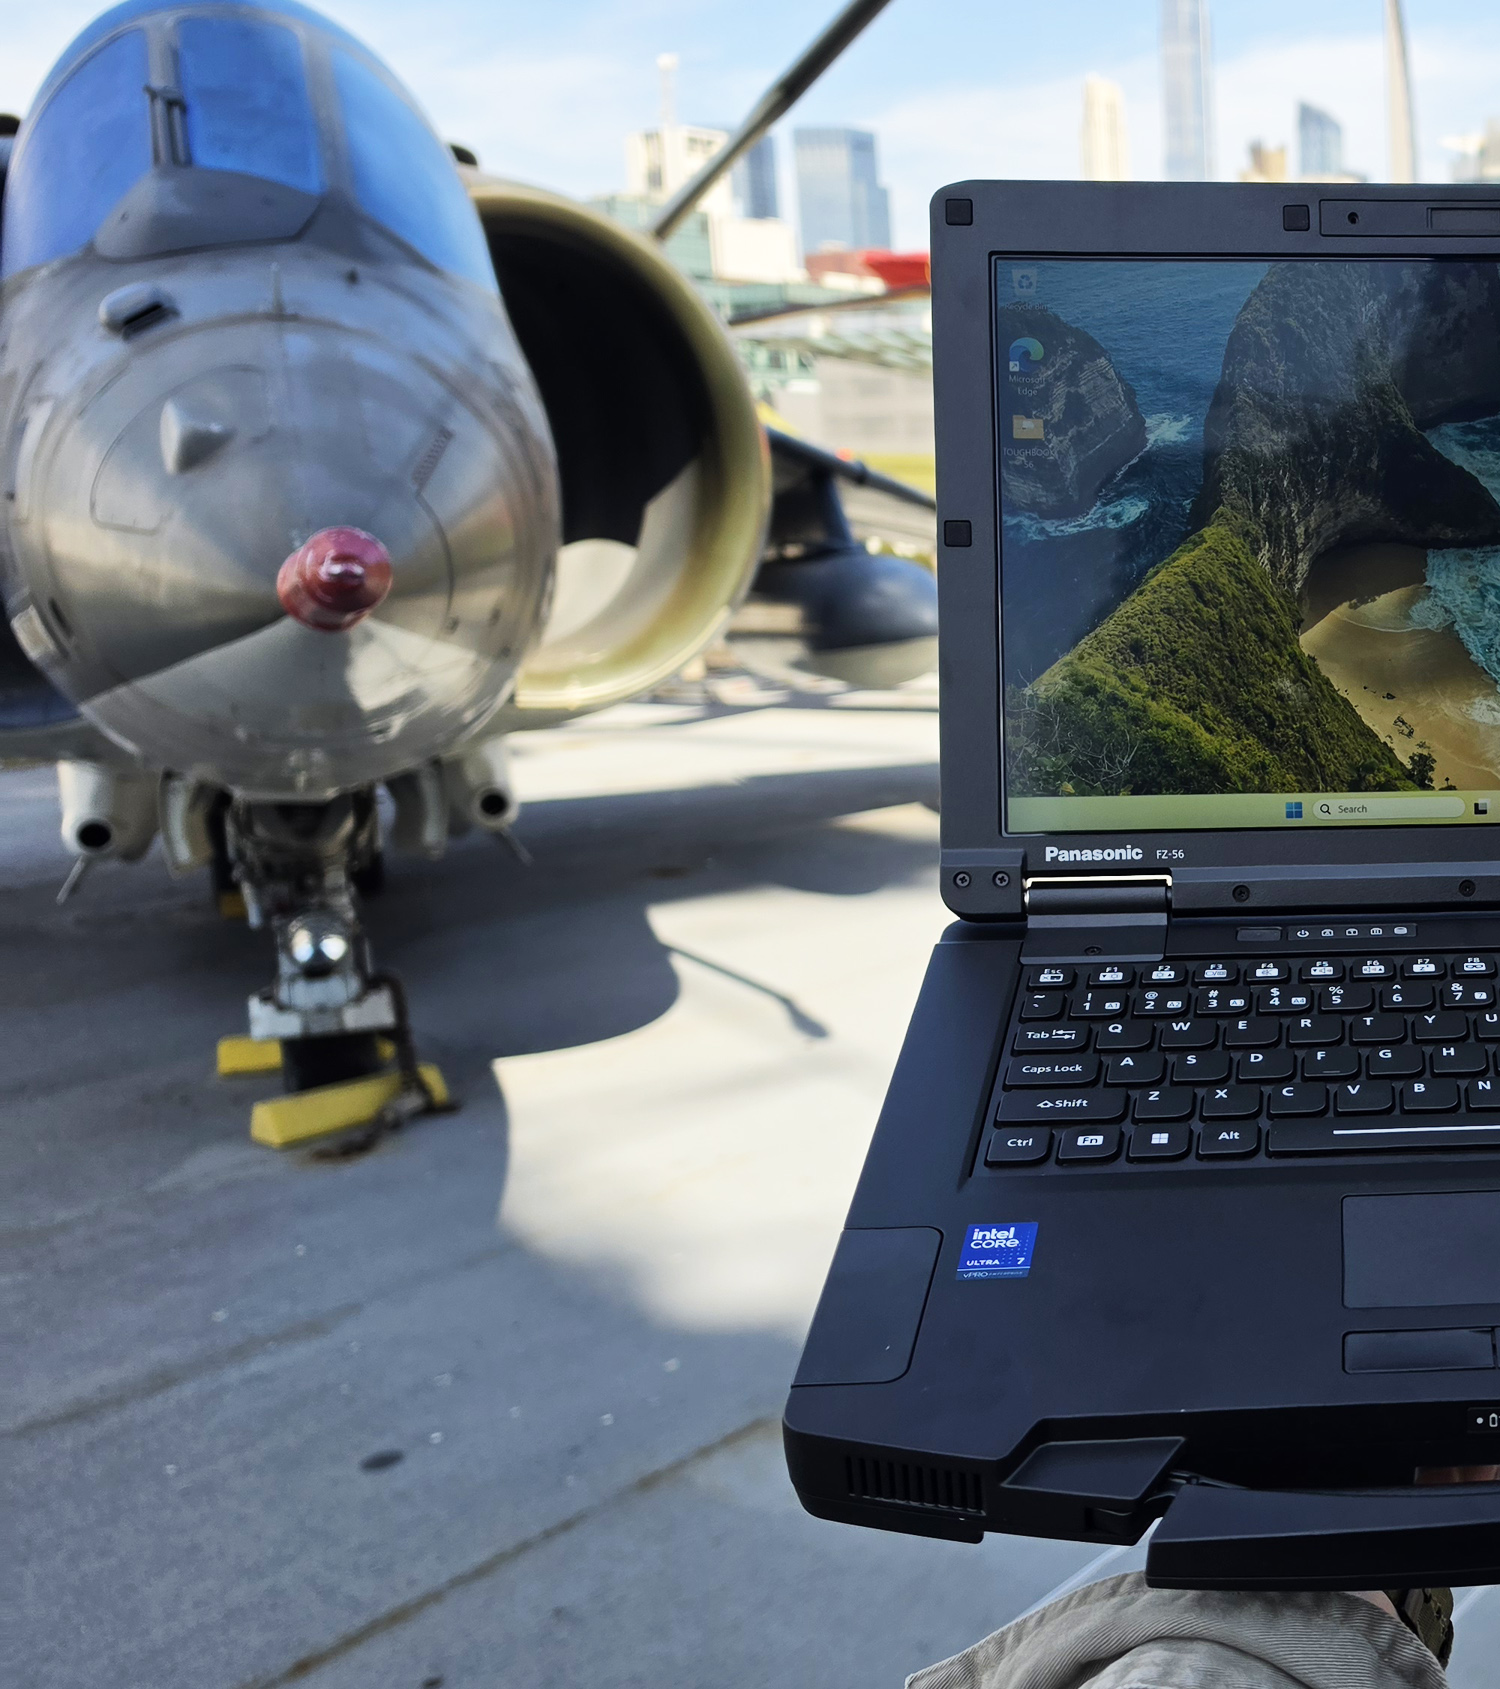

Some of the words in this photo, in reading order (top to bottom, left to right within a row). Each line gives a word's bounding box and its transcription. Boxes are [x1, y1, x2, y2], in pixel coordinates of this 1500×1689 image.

[1338, 805, 1367, 814] Search
[1045, 845, 1143, 862] Panasonic
[1156, 850, 1185, 859] FZ-56
[1328, 986, 1344, 995] %
[1451, 983, 1463, 991] &
[1145, 991, 1159, 1000] @
[1208, 989, 1219, 998] #
[1270, 987, 1280, 997] $
[1453, 992, 1463, 1000] 7
[1269, 997, 1280, 1006] 4
[1332, 995, 1342, 1004] 5
[1392, 993, 1403, 1002] 6
[1083, 1002, 1091, 1011] 1
[1145, 1001, 1155, 1010] 2
[1208, 999, 1218, 1008] 3
[1362, 1017, 1374, 1026] T
[1424, 1015, 1436, 1024] Y
[1485, 1013, 1498, 1022] U
[1172, 1022, 1190, 1031] W
[1238, 1020, 1247, 1030] E
[1300, 1018, 1312, 1028] R
[1108, 1024, 1122, 1034] Q
[1026, 1031, 1049, 1039] Tab
[1316, 1051, 1326, 1060] F
[1379, 1049, 1392, 1059] G
[1442, 1047, 1454, 1057] H
[1120, 1057, 1134, 1066] A
[1186, 1055, 1197, 1065] S
[1250, 1053, 1263, 1063] D
[1022, 1065, 1051, 1074] Caps
[1054, 1063, 1082, 1072] Lock
[1347, 1085, 1361, 1095] V
[1414, 1083, 1426, 1093] B
[1478, 1081, 1492, 1091] N
[1148, 1092, 1160, 1100] Z
[1214, 1089, 1228, 1099] X
[1282, 1087, 1294, 1097] C
[1055, 1099, 1088, 1107] Shift
[1218, 1131, 1240, 1140] Alt
[1007, 1138, 1033, 1147] Ctrl
[973, 1227, 1015, 1240] intel
[1017, 1257, 1025, 1265] 7
